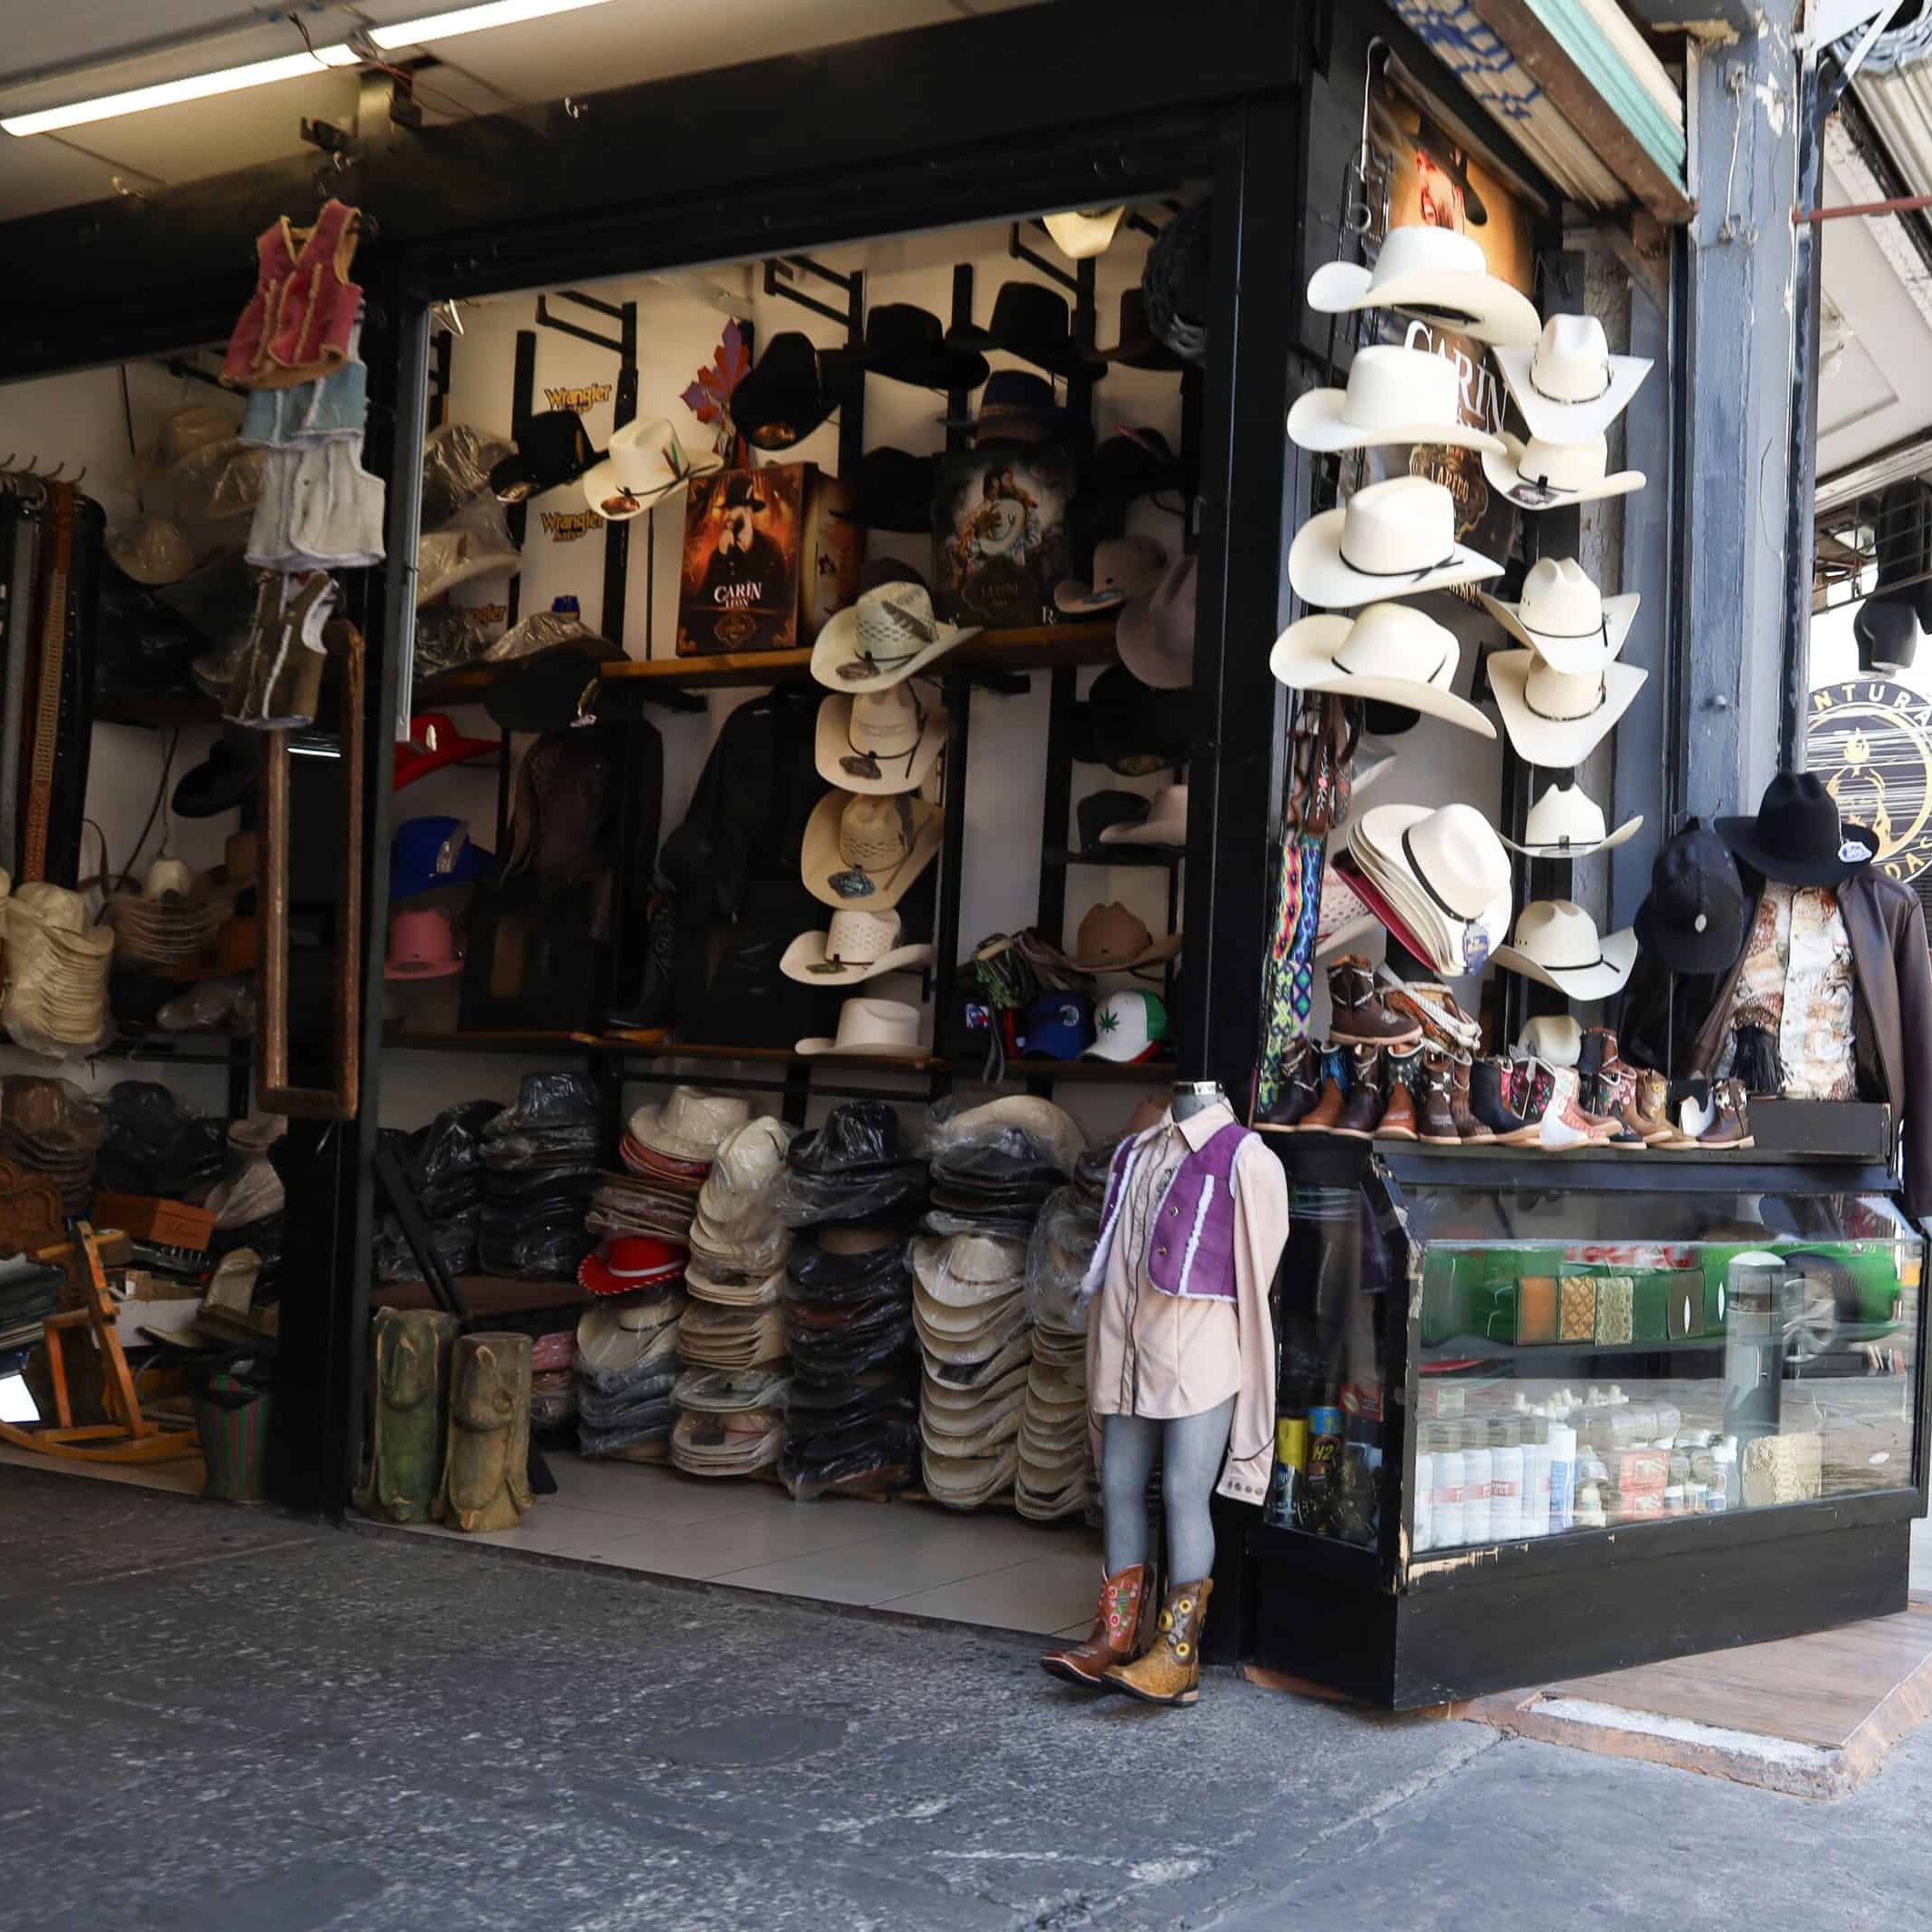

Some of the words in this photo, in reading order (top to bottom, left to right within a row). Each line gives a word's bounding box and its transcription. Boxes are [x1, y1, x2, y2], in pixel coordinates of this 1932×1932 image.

[543, 382, 612, 413] Wrangler
[541, 510, 604, 538] Wrangler
[1813, 683, 1931, 729] NTURA
